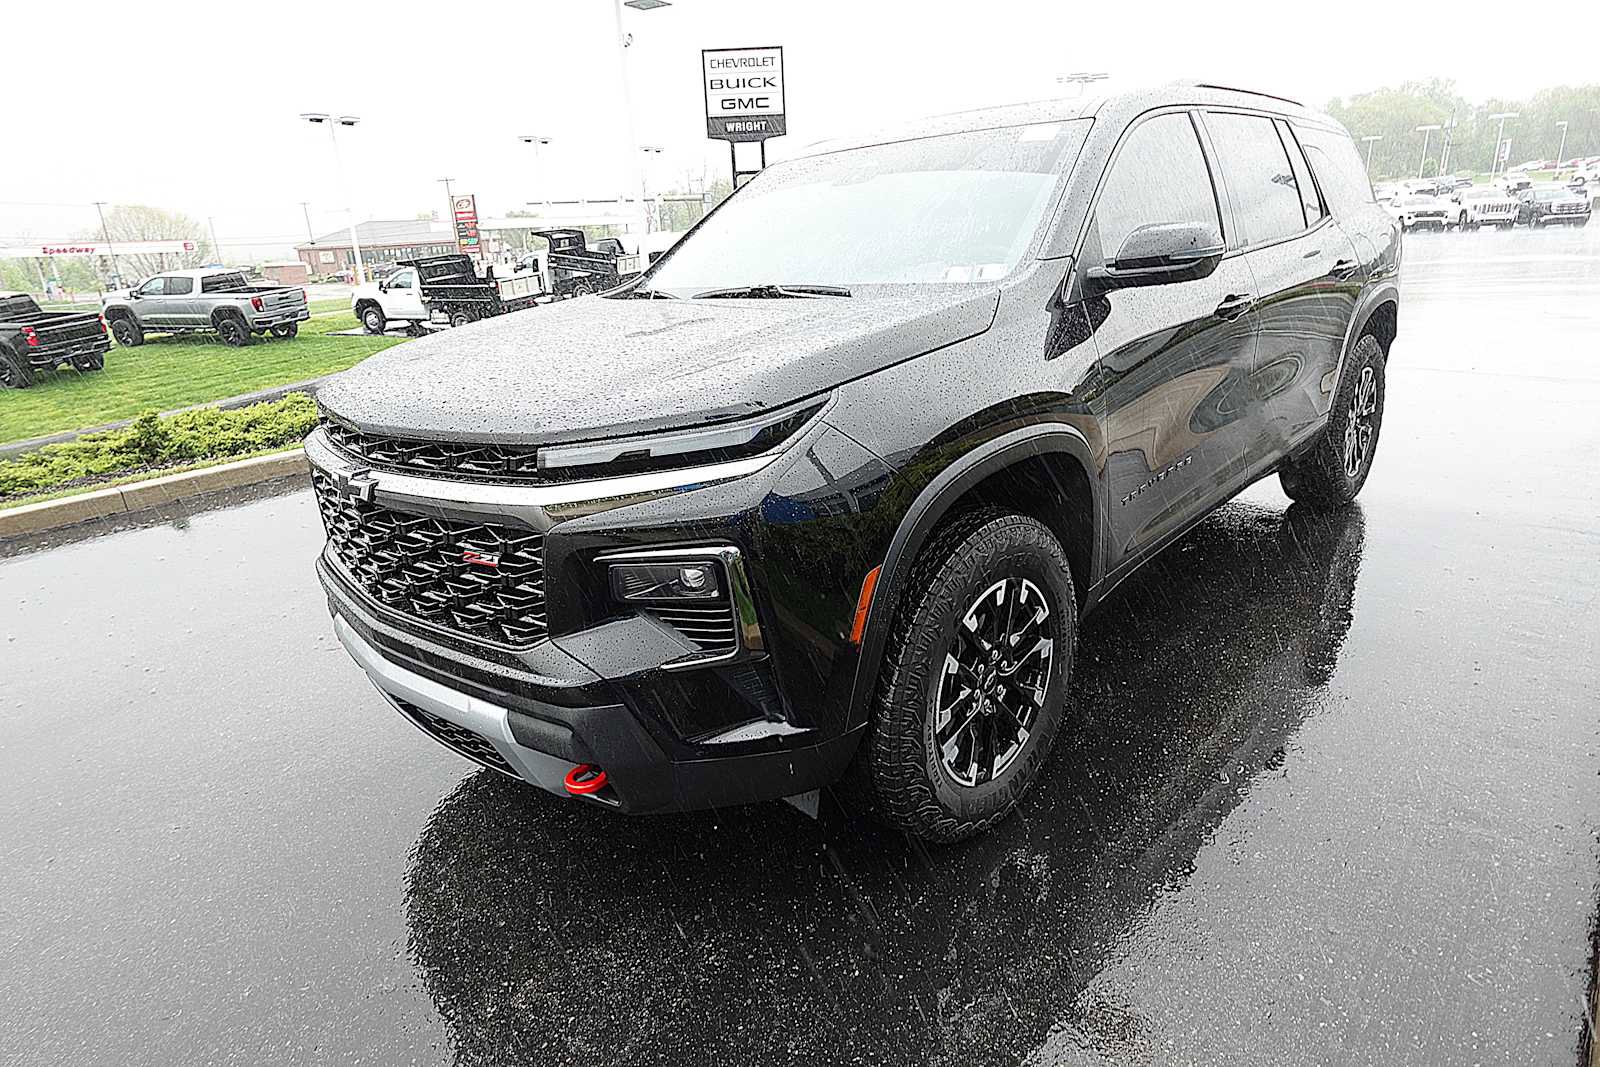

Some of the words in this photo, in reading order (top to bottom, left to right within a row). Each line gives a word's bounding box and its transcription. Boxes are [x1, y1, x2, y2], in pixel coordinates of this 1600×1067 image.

[710, 57, 776, 69] CHEVROLET
[710, 77, 777, 90] BUICK
[721, 97, 770, 110] GMC
[725, 120, 767, 133] WRIGHT
